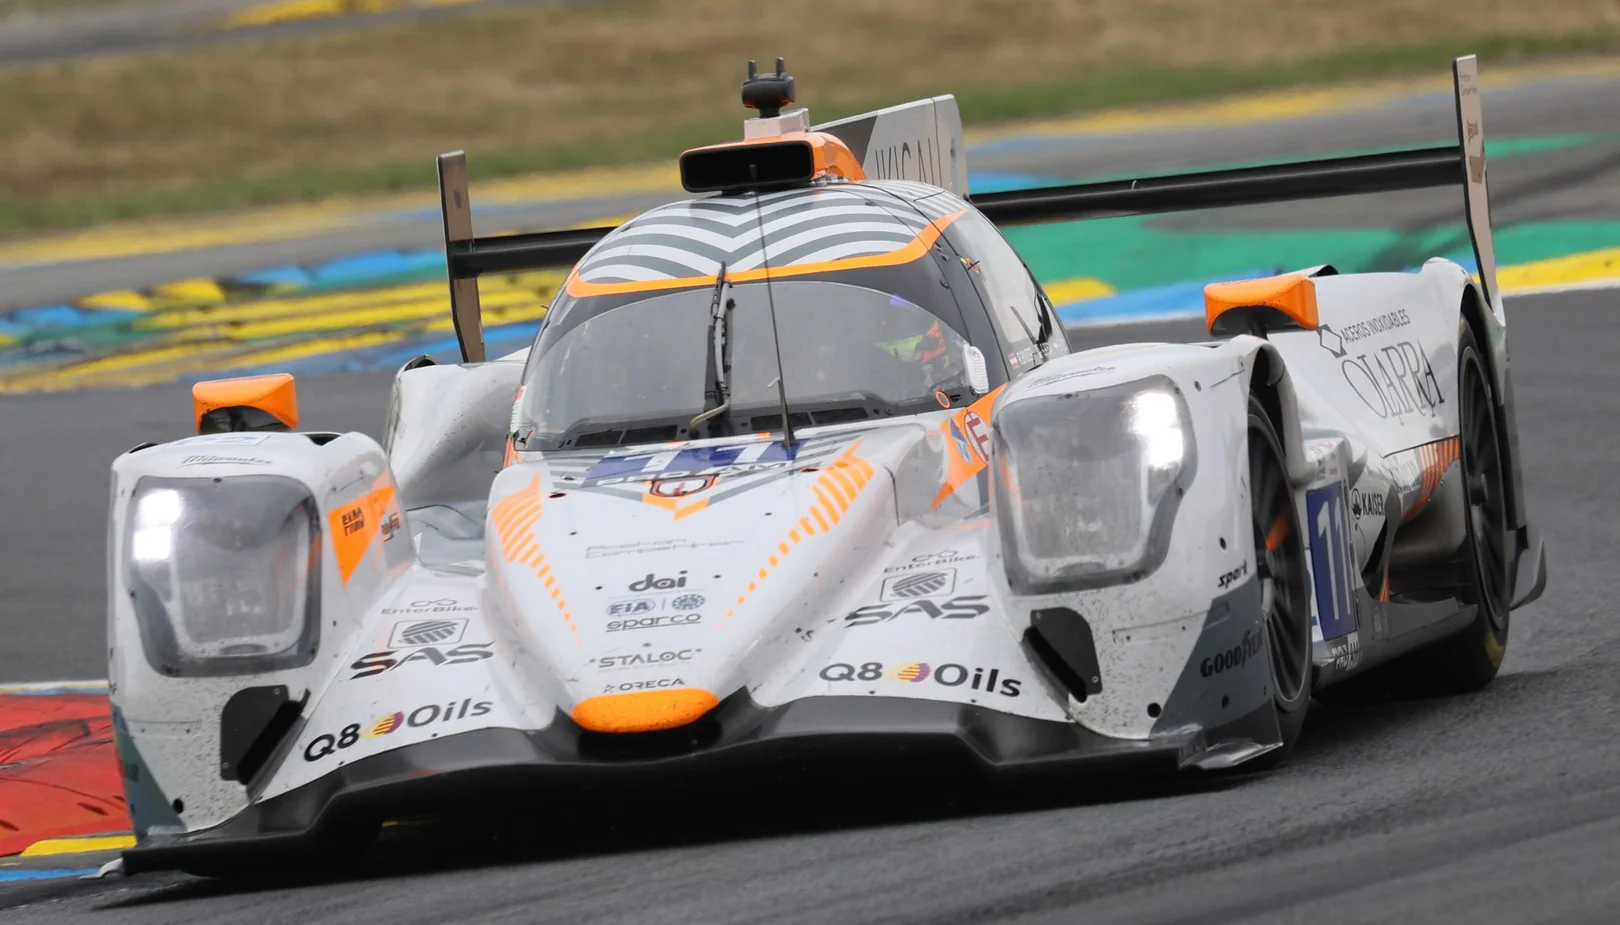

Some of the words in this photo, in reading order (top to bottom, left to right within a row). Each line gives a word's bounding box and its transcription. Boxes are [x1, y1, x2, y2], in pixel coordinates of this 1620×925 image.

[1340, 320, 1371, 343] ACEROS
[1367, 308, 1411, 335] INOXIDABLES
[1361, 492, 1385, 516] KAISER
[1316, 495, 1351, 621] 11
[629, 570, 688, 592] dai
[609, 601, 650, 615] FIA
[844, 595, 991, 628] SAS
[606, 613, 702, 632] sparco
[348, 641, 497, 680] SAS
[598, 649, 693, 668] STALOC
[619, 678, 685, 691] ORECA
[819, 662, 884, 682] Q8
[933, 664, 1022, 698] Oils
[303, 723, 361, 763] Q8
[407, 697, 493, 729] Oils
